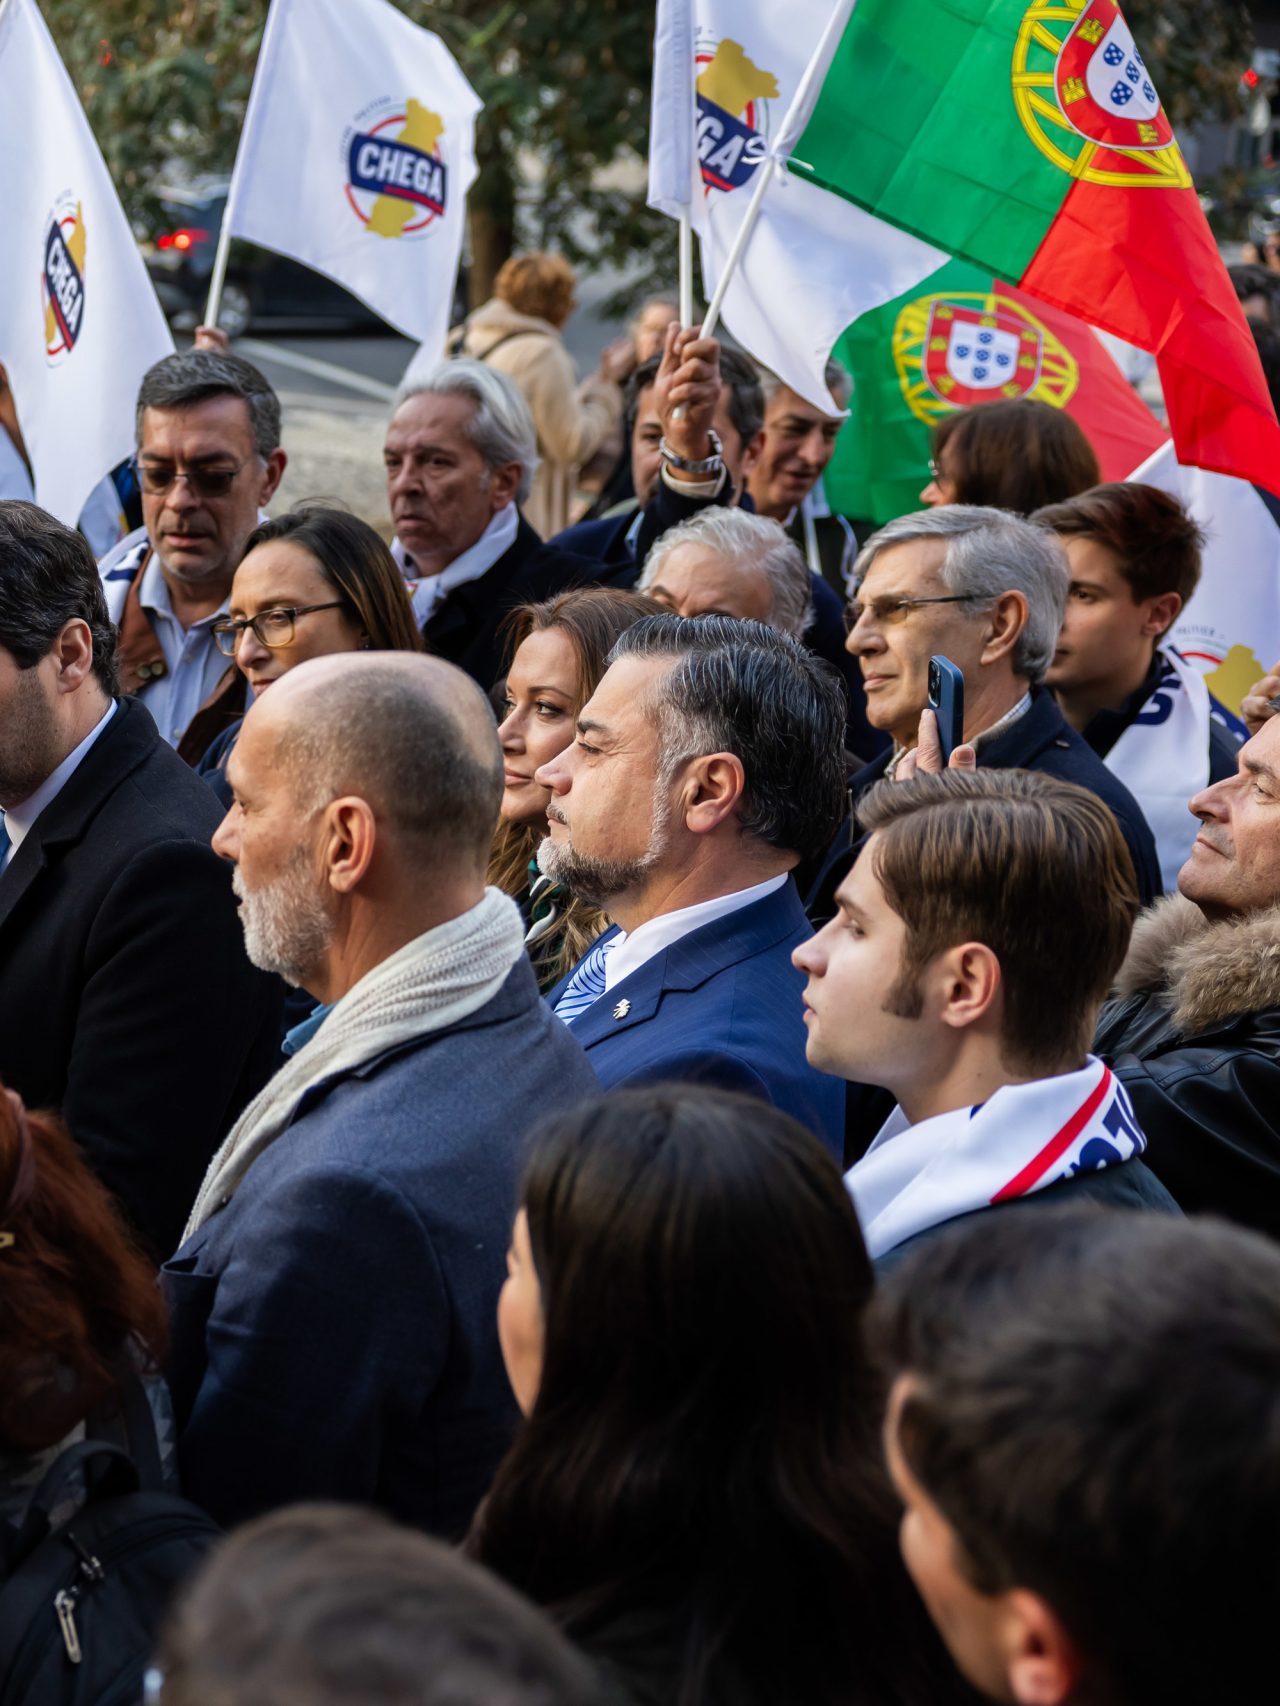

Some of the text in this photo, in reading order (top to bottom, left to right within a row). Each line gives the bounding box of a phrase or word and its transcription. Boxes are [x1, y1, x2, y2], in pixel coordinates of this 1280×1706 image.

[356, 143, 444, 202] CHEGA
[696, 107, 746, 178] GA
[47, 236, 83, 333] CHEGA
